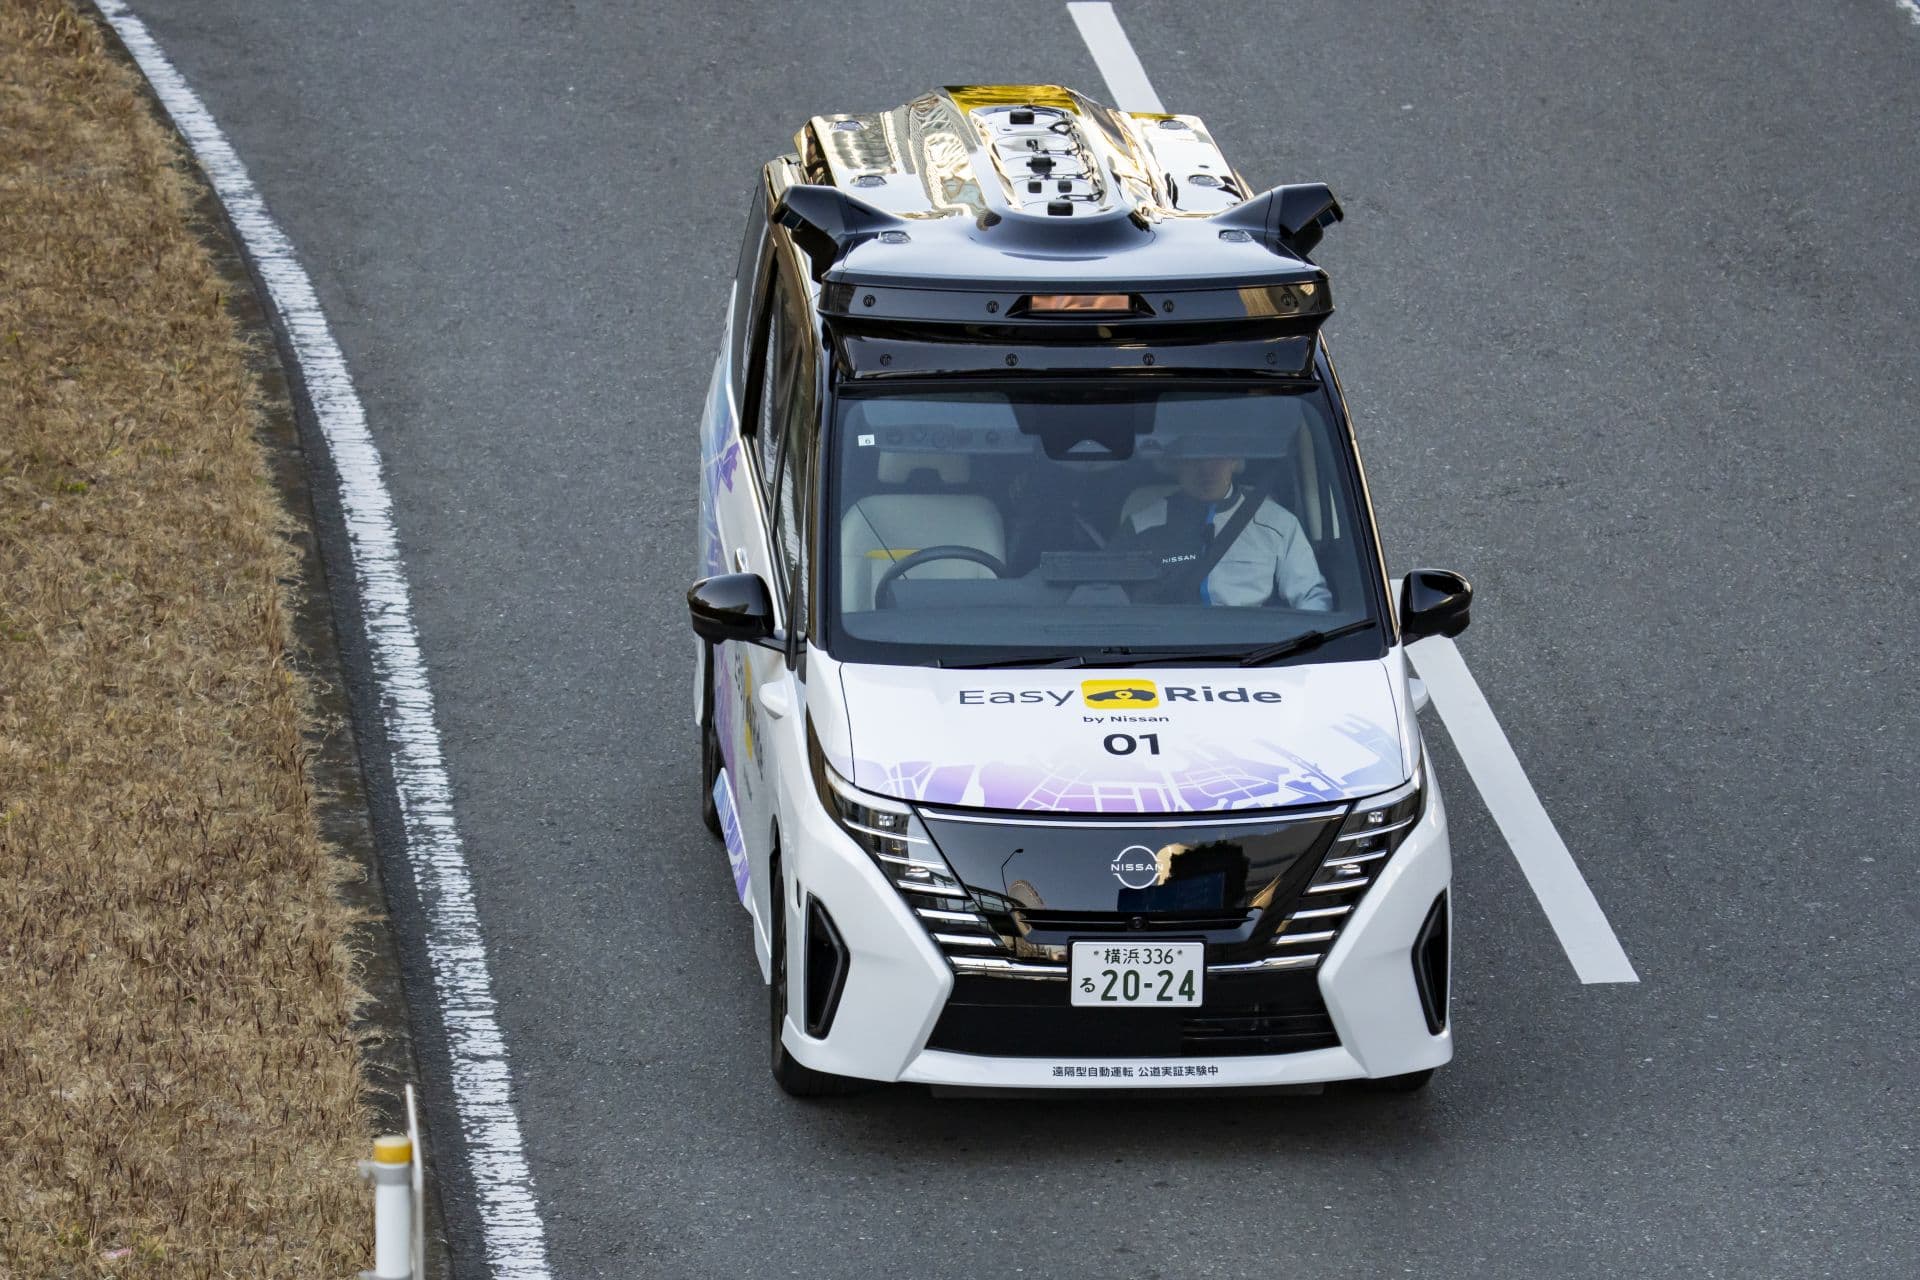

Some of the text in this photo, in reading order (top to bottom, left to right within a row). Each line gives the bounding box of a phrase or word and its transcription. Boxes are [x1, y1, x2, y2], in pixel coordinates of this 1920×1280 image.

[1162, 554, 1196, 564] NISSAN
[959, 687, 1282, 706] Easy Ride
[1083, 716, 1105, 724] by
[1103, 733, 1161, 755] 01
[1111, 863, 1163, 871] NISSAN
[1080, 969, 1195, 1002] る 20-24
[1138, 1065, 1219, 1077] 公道実証実験中
